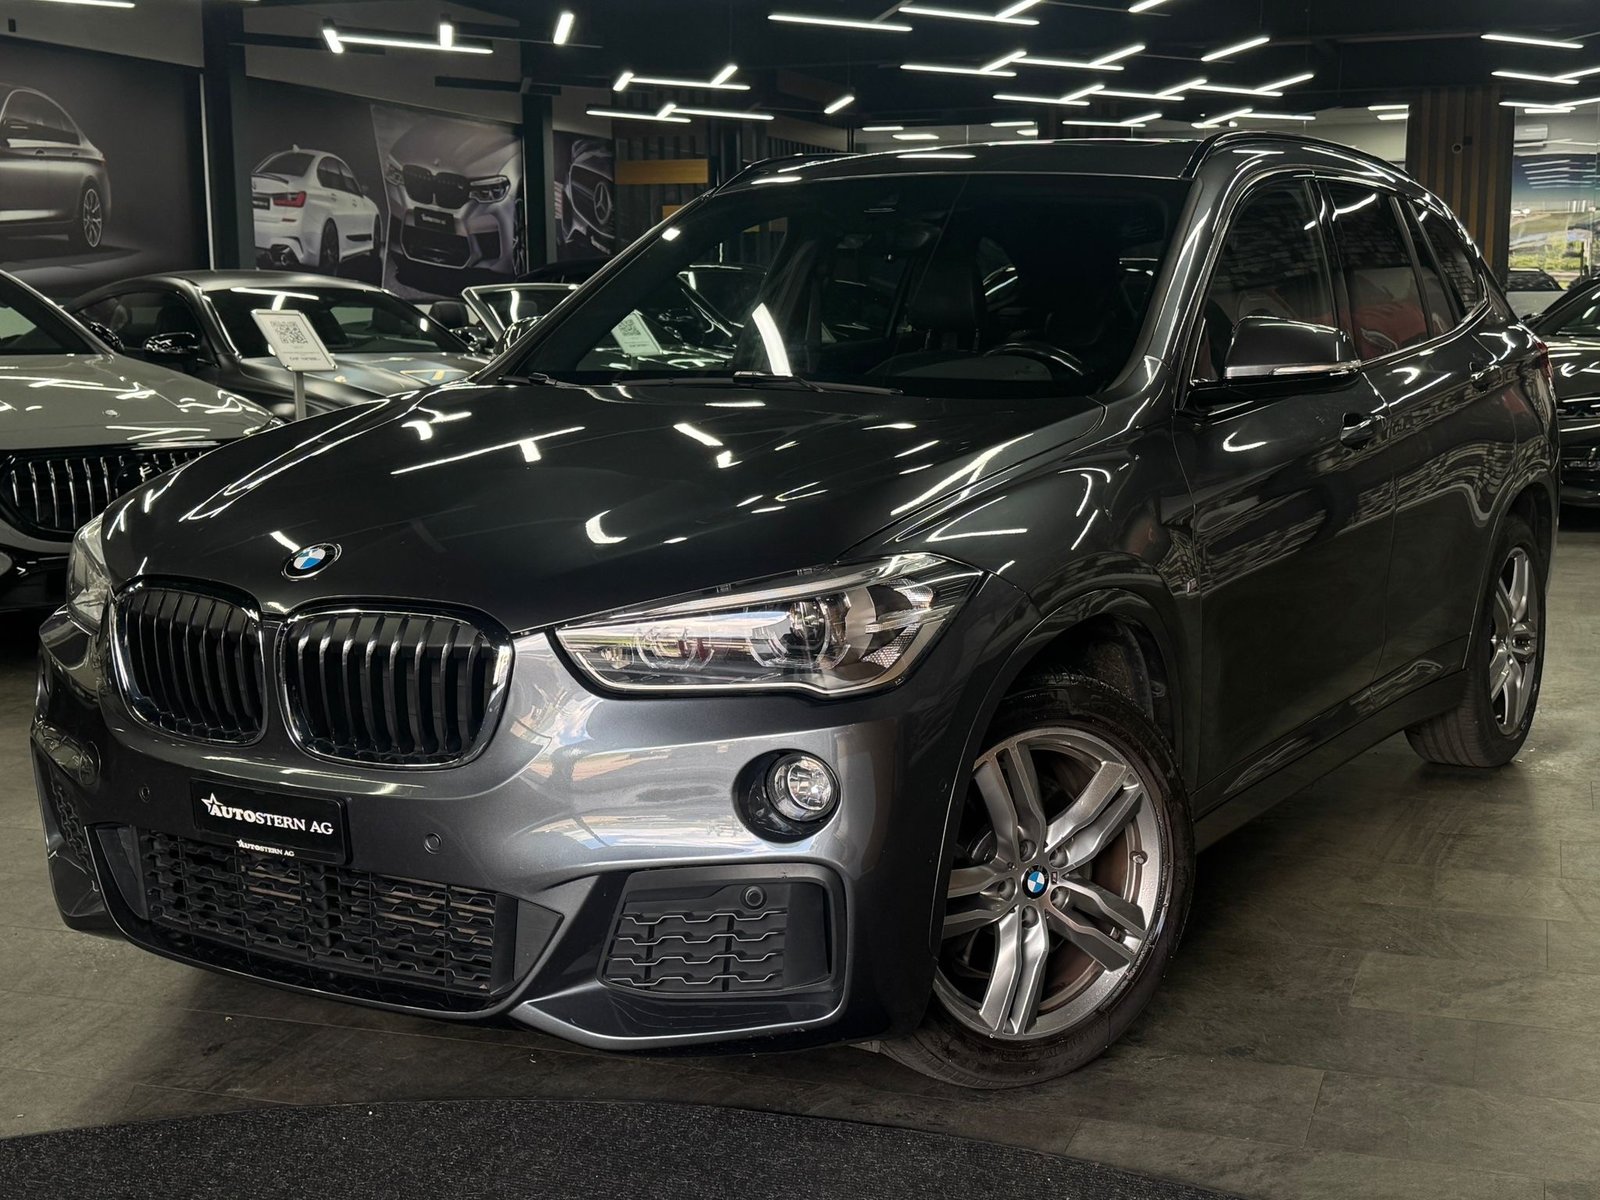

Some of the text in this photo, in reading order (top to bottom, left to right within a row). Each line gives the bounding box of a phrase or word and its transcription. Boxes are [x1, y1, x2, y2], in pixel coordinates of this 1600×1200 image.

[209, 803, 334, 835] AUTOSTERN AG
[238, 841, 283, 855] AUTOSTERN
